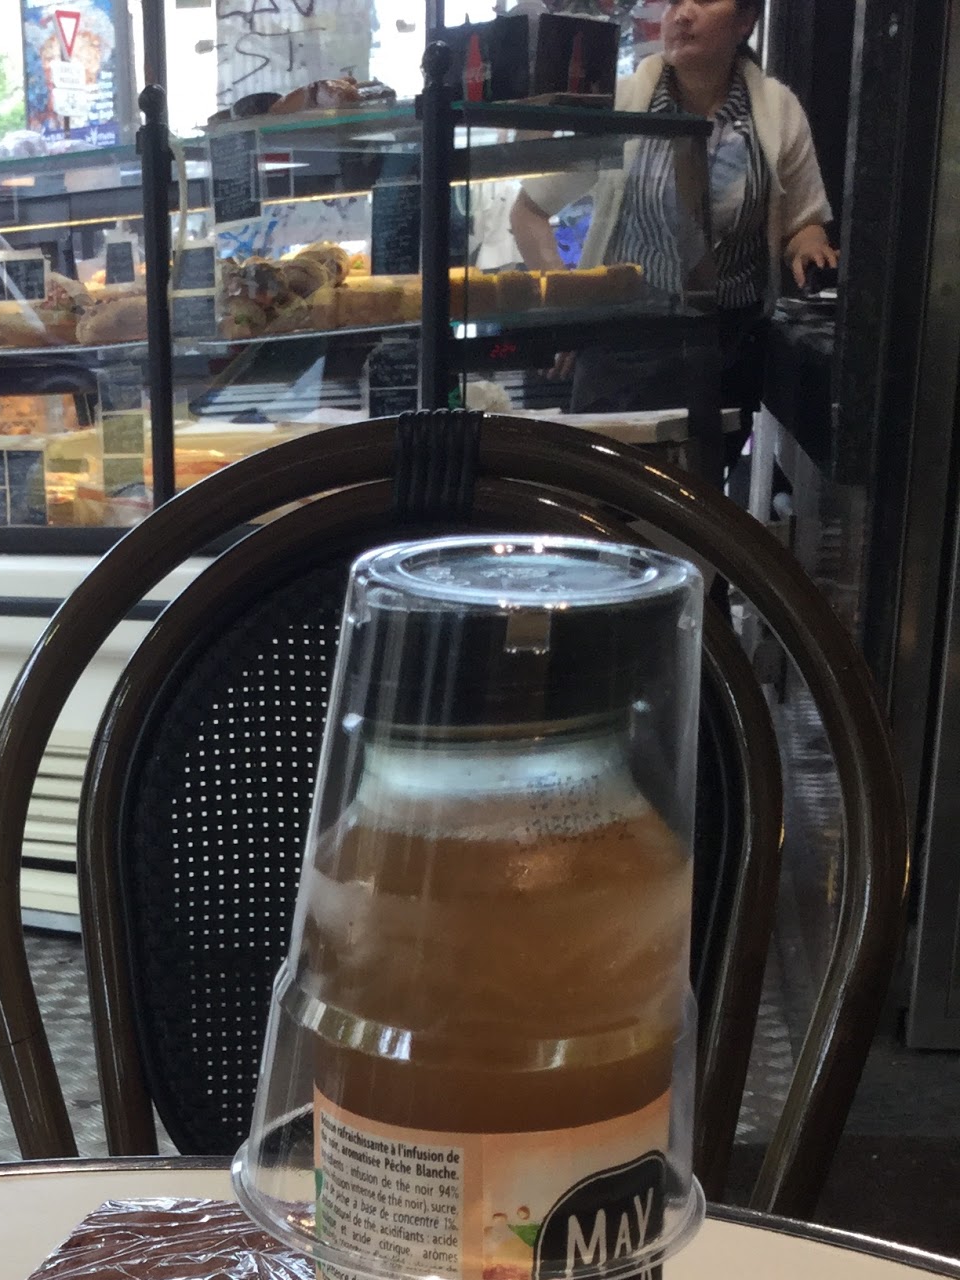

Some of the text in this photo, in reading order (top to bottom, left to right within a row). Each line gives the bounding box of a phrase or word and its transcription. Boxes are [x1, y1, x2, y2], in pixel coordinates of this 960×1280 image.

[397, 1143, 444, 1162] l'infusion
[445, 1149, 460, 1164] de
[415, 1163, 459, 1180] Blanche.
[380, 1174, 392, 1189] de
[414, 1184, 433, 1196] noir
[438, 1184, 459, 1199] 94%
[360, 1198, 377, 1215] base
[379, 1205, 389, 1221] de
[380, 1224, 424, 1243] acidifiants
[432, 1233, 458, 1247] acide
[422, 1248, 457, 1263] arômes
